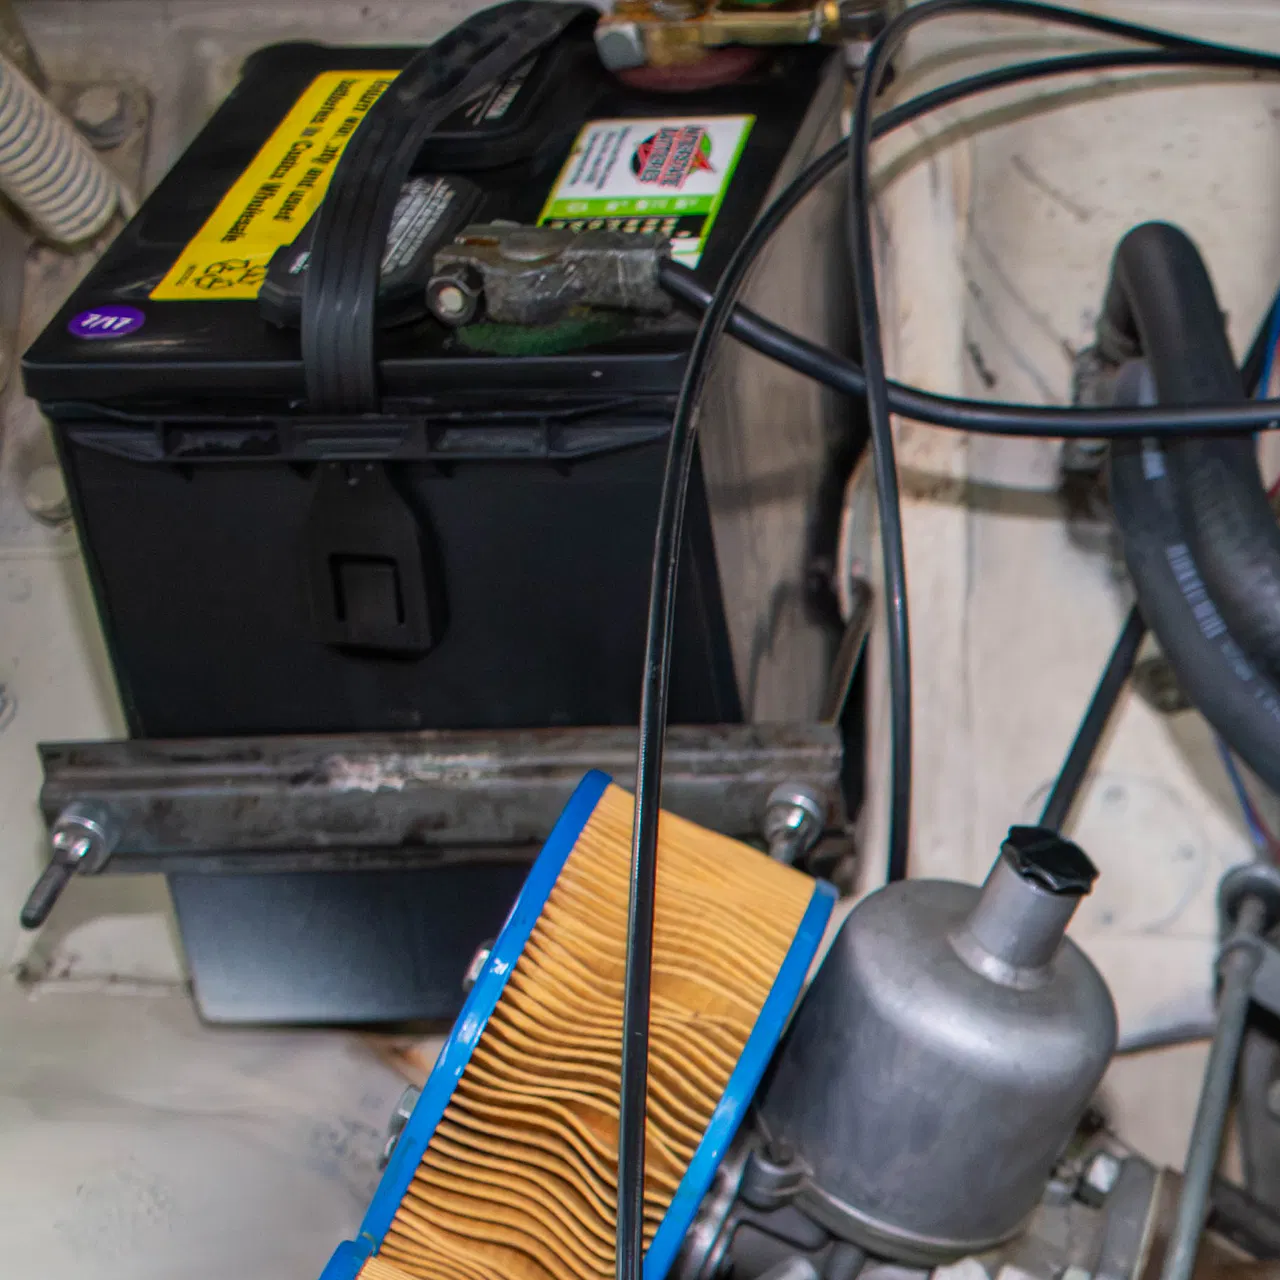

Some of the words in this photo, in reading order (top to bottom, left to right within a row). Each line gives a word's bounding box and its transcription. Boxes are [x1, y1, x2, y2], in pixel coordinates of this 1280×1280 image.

[269, 139, 314, 180] Costco
[660, 125, 705, 188] INTERSTATE
[296, 167, 323, 188] and
[220, 182, 284, 243] Wholesale
[272, 190, 307, 222] used
